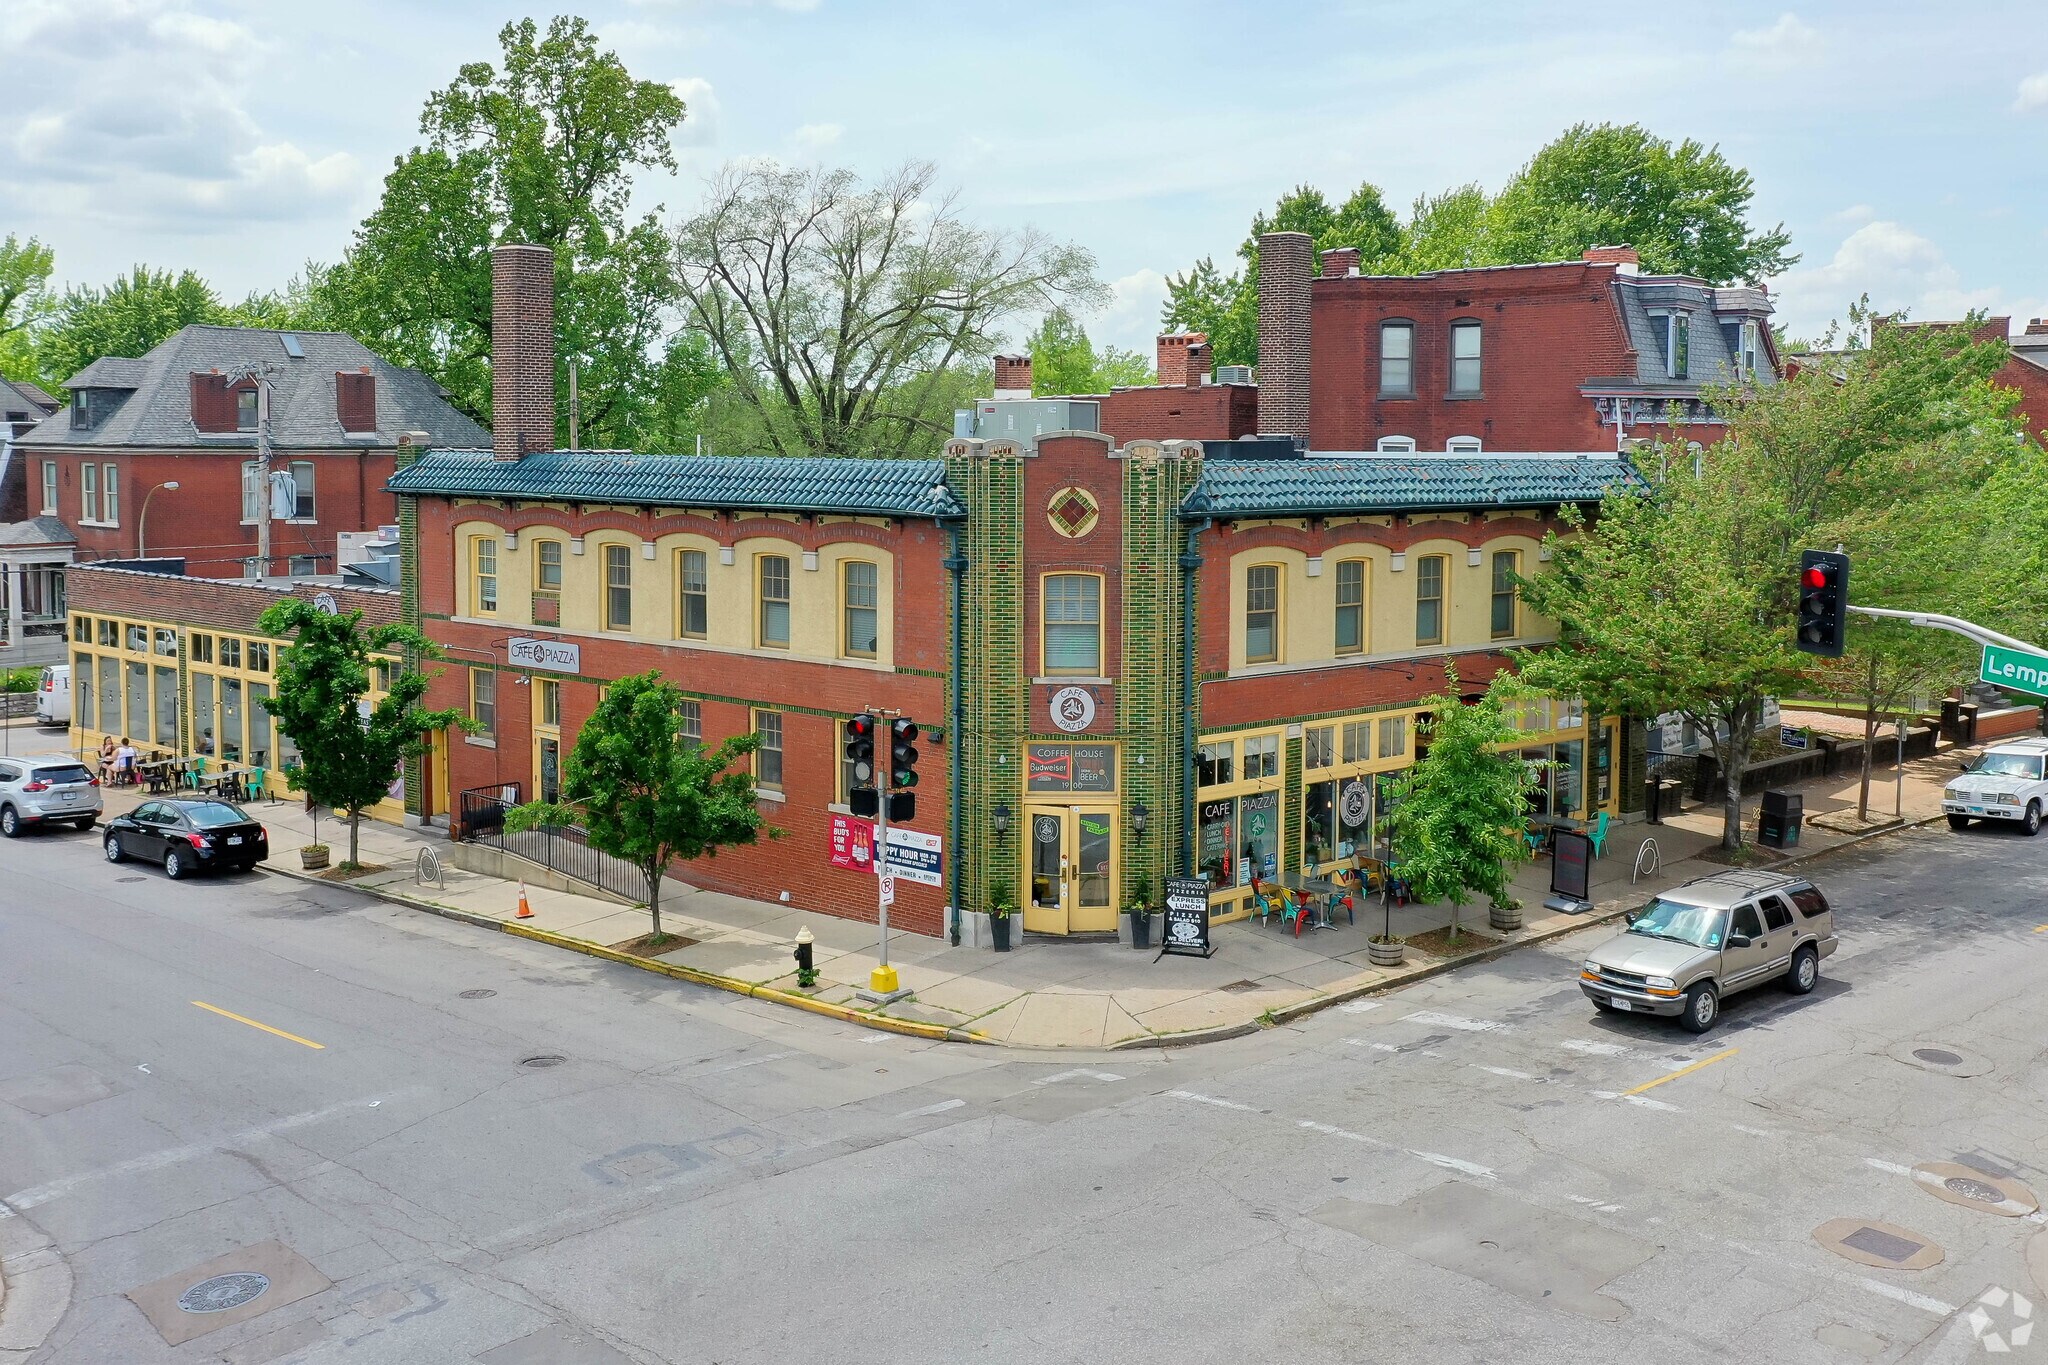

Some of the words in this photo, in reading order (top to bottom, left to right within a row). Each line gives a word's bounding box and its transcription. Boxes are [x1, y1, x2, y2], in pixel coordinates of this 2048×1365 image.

[511, 645, 533, 659] CAFE
[545, 649, 576, 665] PIAZZA
[1060, 689, 1084, 699] CAFE
[1059, 719, 1088, 730] PIAZZA
[1037, 748, 1069, 757] COFFEE
[1074, 749, 1104, 758] HOUSE
[1030, 762, 1067, 772] Budweiser
[1080, 773, 1098, 781] BEER
[1346, 783, 1364, 793] CAFE
[1205, 803, 1230, 817] CAFE
[1241, 795, 1277, 812] PIAZZA
[834, 819, 846, 828] THIS
[1344, 813, 1366, 826] PIAZZA
[833, 827, 849, 837] BUD'S
[1206, 829, 1222, 837] LUNCH
[833, 836, 845, 844] FOR
[1206, 836, 1223, 845] DINNER
[834, 844, 846, 852] YOU.
[1223, 821, 1231, 877] DELIVERY
[899, 848, 919, 860] HOUR
[1167, 888, 1204, 896] PIZZERIA
[1171, 896, 1206, 905] EXPRESS
[1169, 911, 1200, 919] PIZZA
